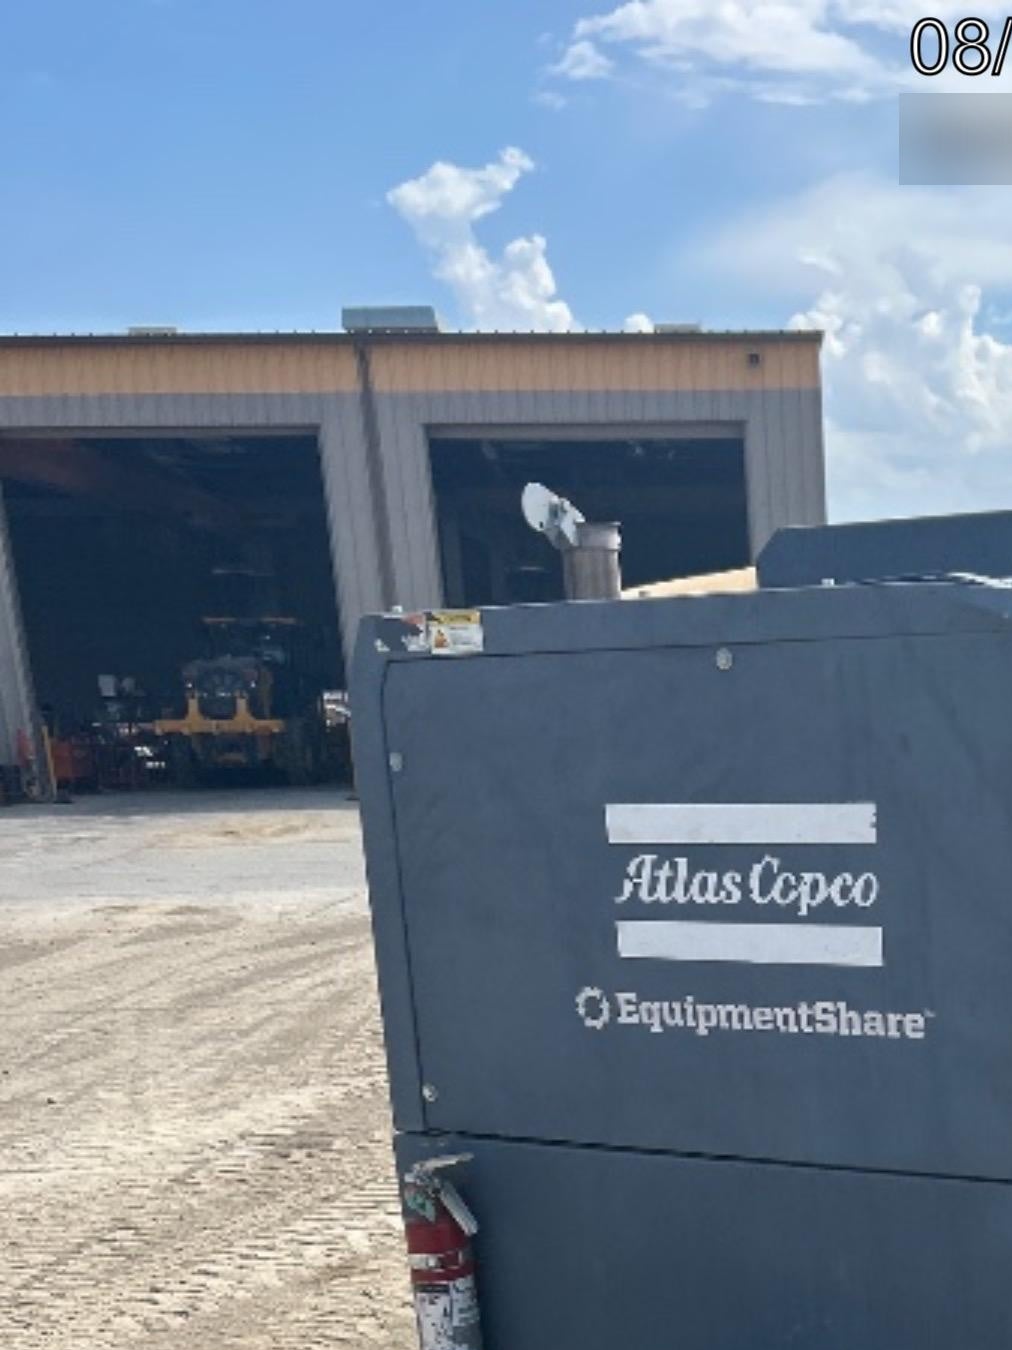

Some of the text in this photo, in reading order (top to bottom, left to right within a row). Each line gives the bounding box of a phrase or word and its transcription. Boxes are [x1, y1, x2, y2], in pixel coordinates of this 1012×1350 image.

[614, 854, 880, 916] Atlas Copco
[614, 992, 927, 1040] EquipmentShare
